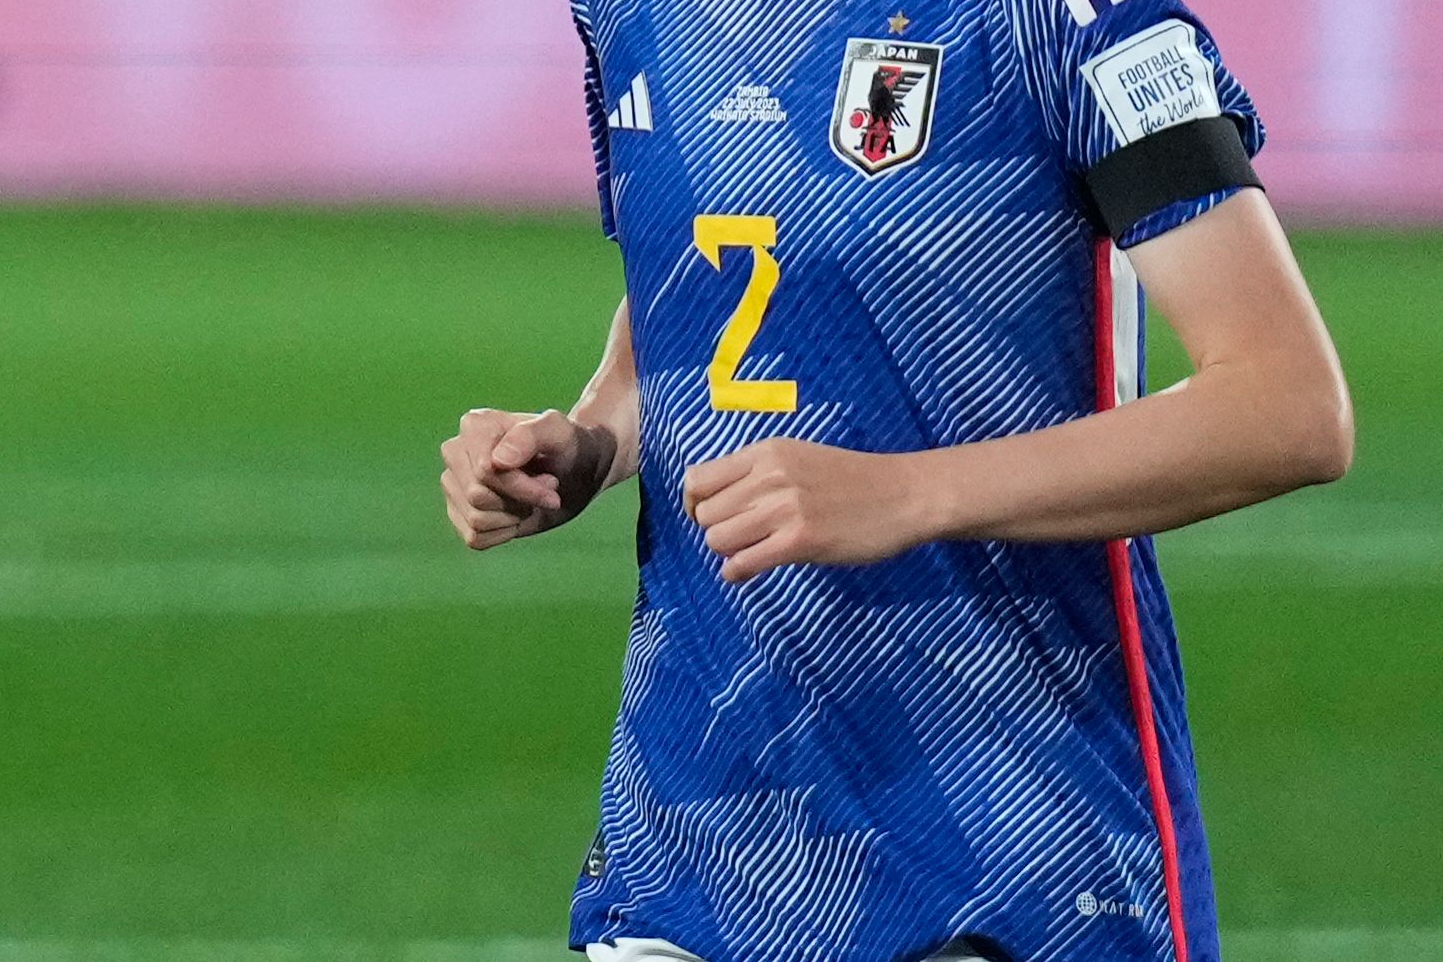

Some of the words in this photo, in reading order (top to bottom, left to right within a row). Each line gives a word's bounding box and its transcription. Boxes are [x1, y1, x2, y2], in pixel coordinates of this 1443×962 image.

[868, 44, 918, 60] JAPAN
[1118, 45, 1185, 90] FOOTBALL
[1127, 63, 1194, 112] UNITES
[1137, 111, 1166, 136] the
[1164, 89, 1205, 122] World
[693, 214, 798, 412] 2
